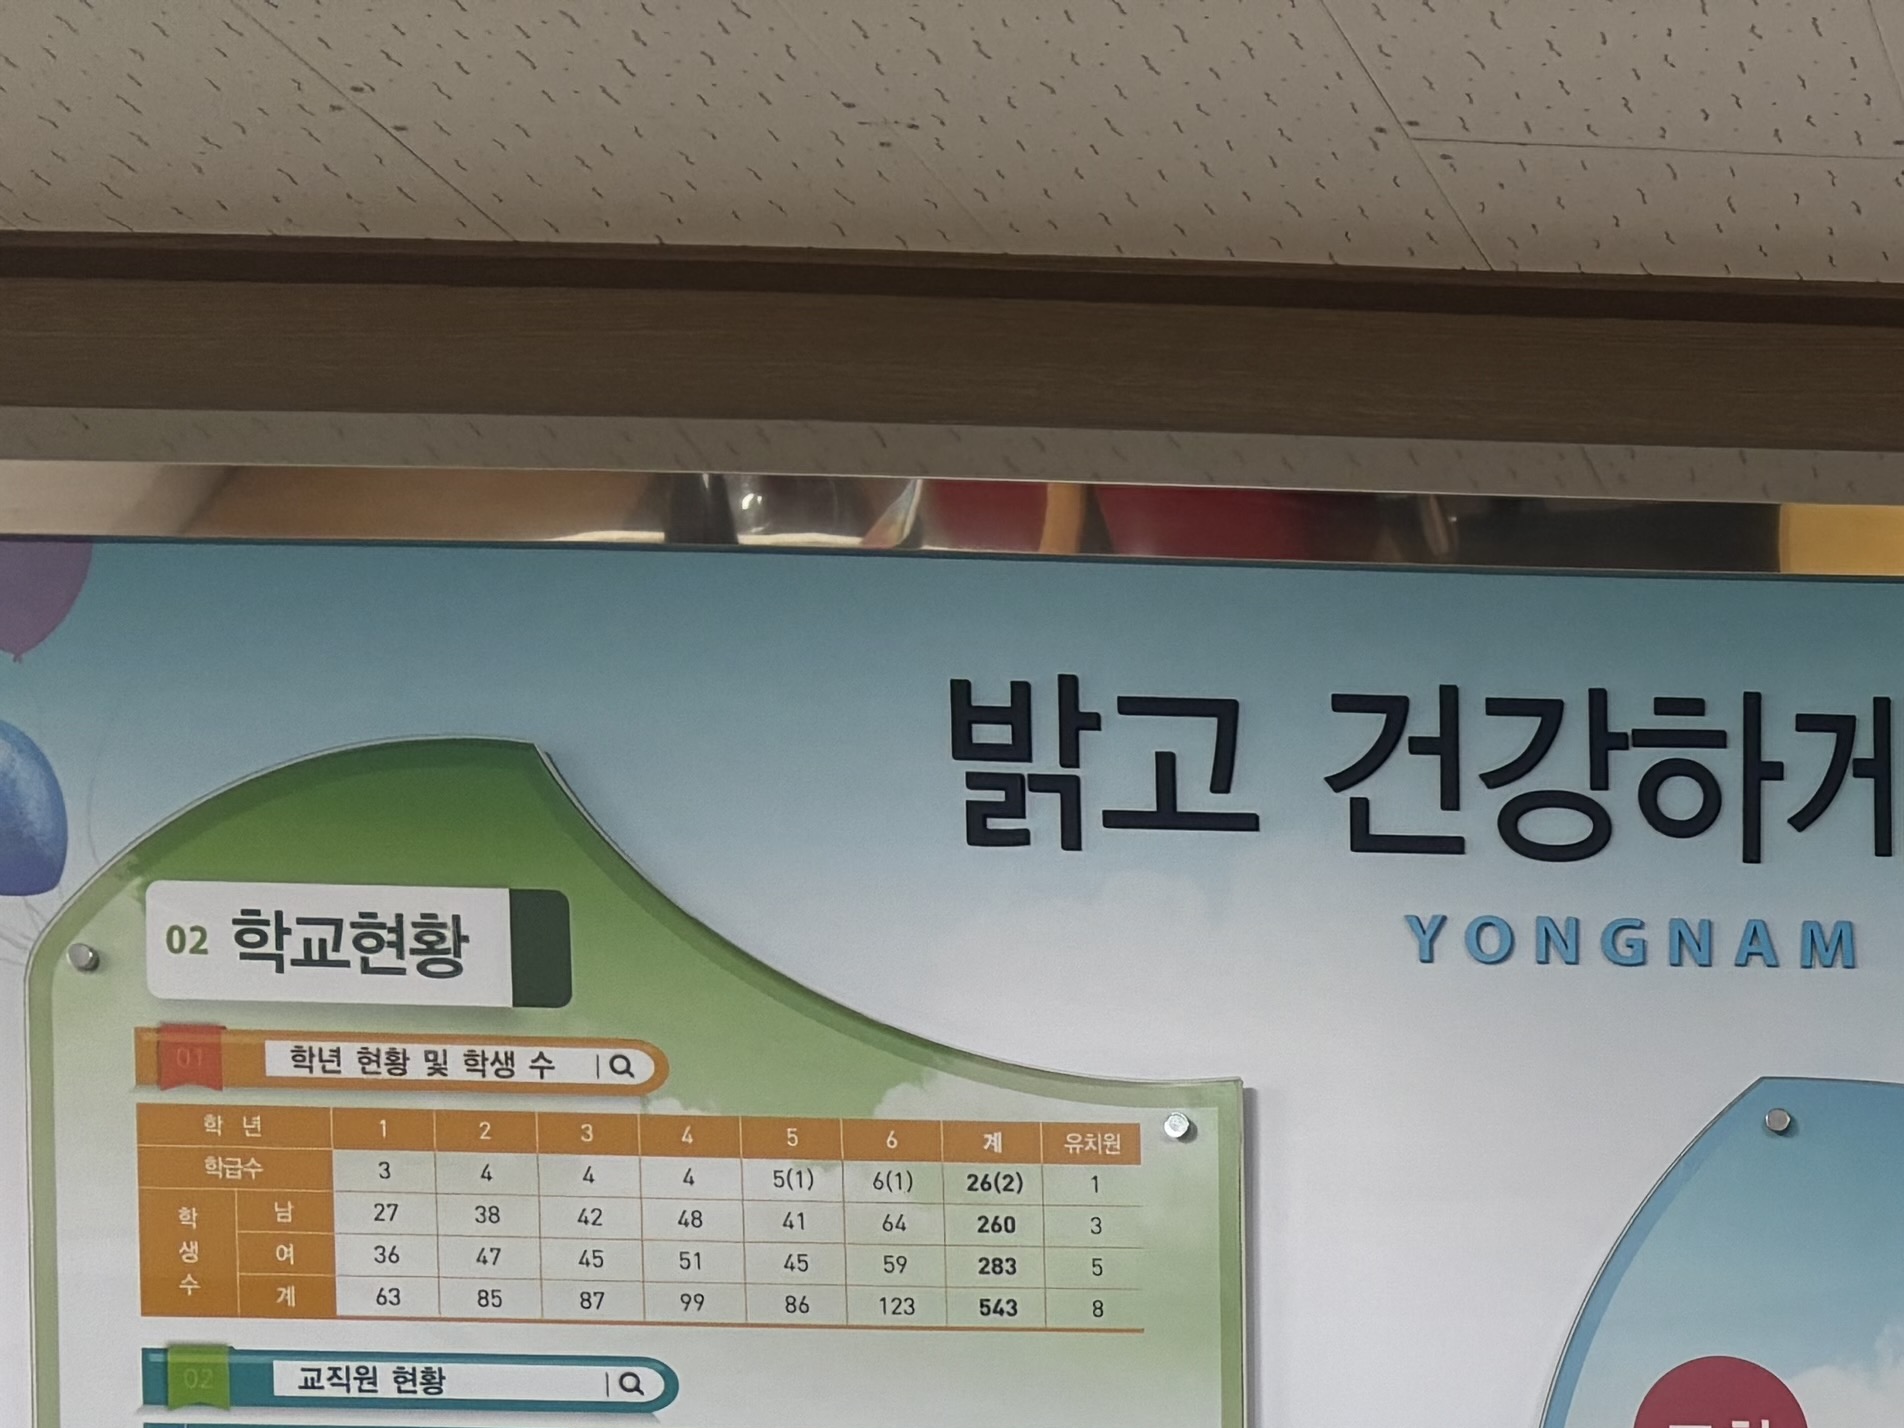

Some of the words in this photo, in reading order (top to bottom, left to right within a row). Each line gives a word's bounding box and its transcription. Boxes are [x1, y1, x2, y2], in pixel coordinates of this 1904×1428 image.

[950, 672, 1260, 851] 밝고
[166, 924, 209, 955] 02
[232, 909, 470, 979] 학교현황
[1403, 914, 1858, 969] YONGNAM
[291, 1046, 341, 1073] 학년
[357, 1047, 409, 1076] 현황
[425, 1050, 447, 1076] 및
[464, 1050, 514, 1078] 학생
[530, 1052, 554, 1079] 수
[984, 1132, 1002, 1153] 계
[1064, 1131, 1120, 1156] 유치원
[202, 1155, 264, 1188] 학급수
[772, 1164, 815, 1193] 5(1)
[873, 1170, 913, 1193] 6(1)
[967, 1171, 1023, 1194] 26(2)
[374, 1203, 399, 1222] 27
[475, 1205, 500, 1224] 38
[577, 1208, 603, 1226] 42
[677, 1210, 703, 1228] 48
[782, 1211, 805, 1230] 41
[881, 1210, 908, 1233] 64
[977, 1215, 1015, 1233] 260
[376, 1287, 401, 1306] 63
[477, 1289, 502, 1308] 85
[580, 1291, 605, 1310] 87
[680, 1293, 705, 1312] 99
[785, 1295, 809, 1314] 86
[880, 1297, 915, 1315] 123
[980, 1298, 1017, 1317] 543
[299, 1366, 377, 1393] 교직원
[393, 1367, 445, 1395] 현황
